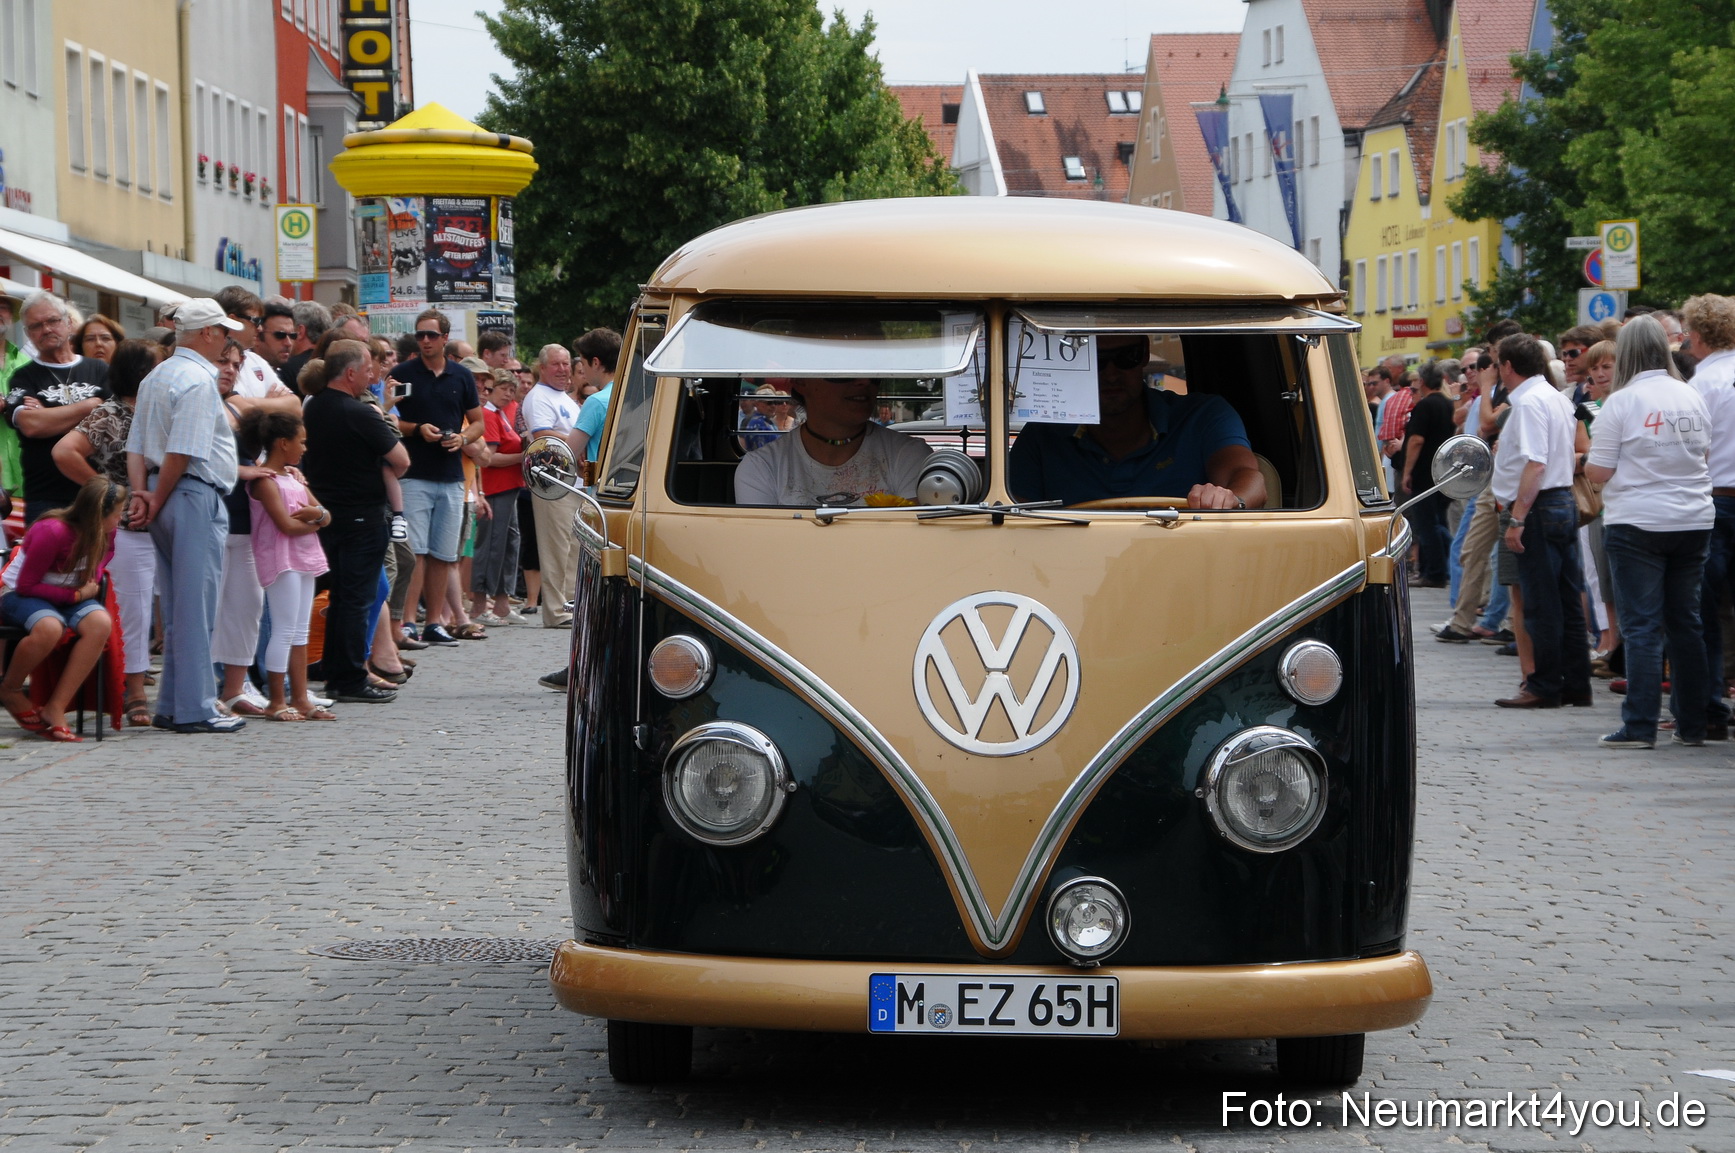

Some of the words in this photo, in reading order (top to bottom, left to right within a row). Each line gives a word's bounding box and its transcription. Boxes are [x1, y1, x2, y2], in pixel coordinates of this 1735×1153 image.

[432, 198, 456, 206] FREITAG
[395, 228, 418, 238] LIVE
[1382, 224, 1400, 247] HOTEL
[433, 232, 486, 248] ALTSTADTFEST
[442, 250, 461, 260] AFTER
[462, 250, 478, 260] PARTY
[390, 285, 416, 296] 24.6.
[1665, 416, 1702, 432] YOU
[898, 982, 924, 1024] M
[958, 983, 1016, 1026] EZ
[1028, 984, 1114, 1027] 65H
[878, 1009, 888, 1021] D
